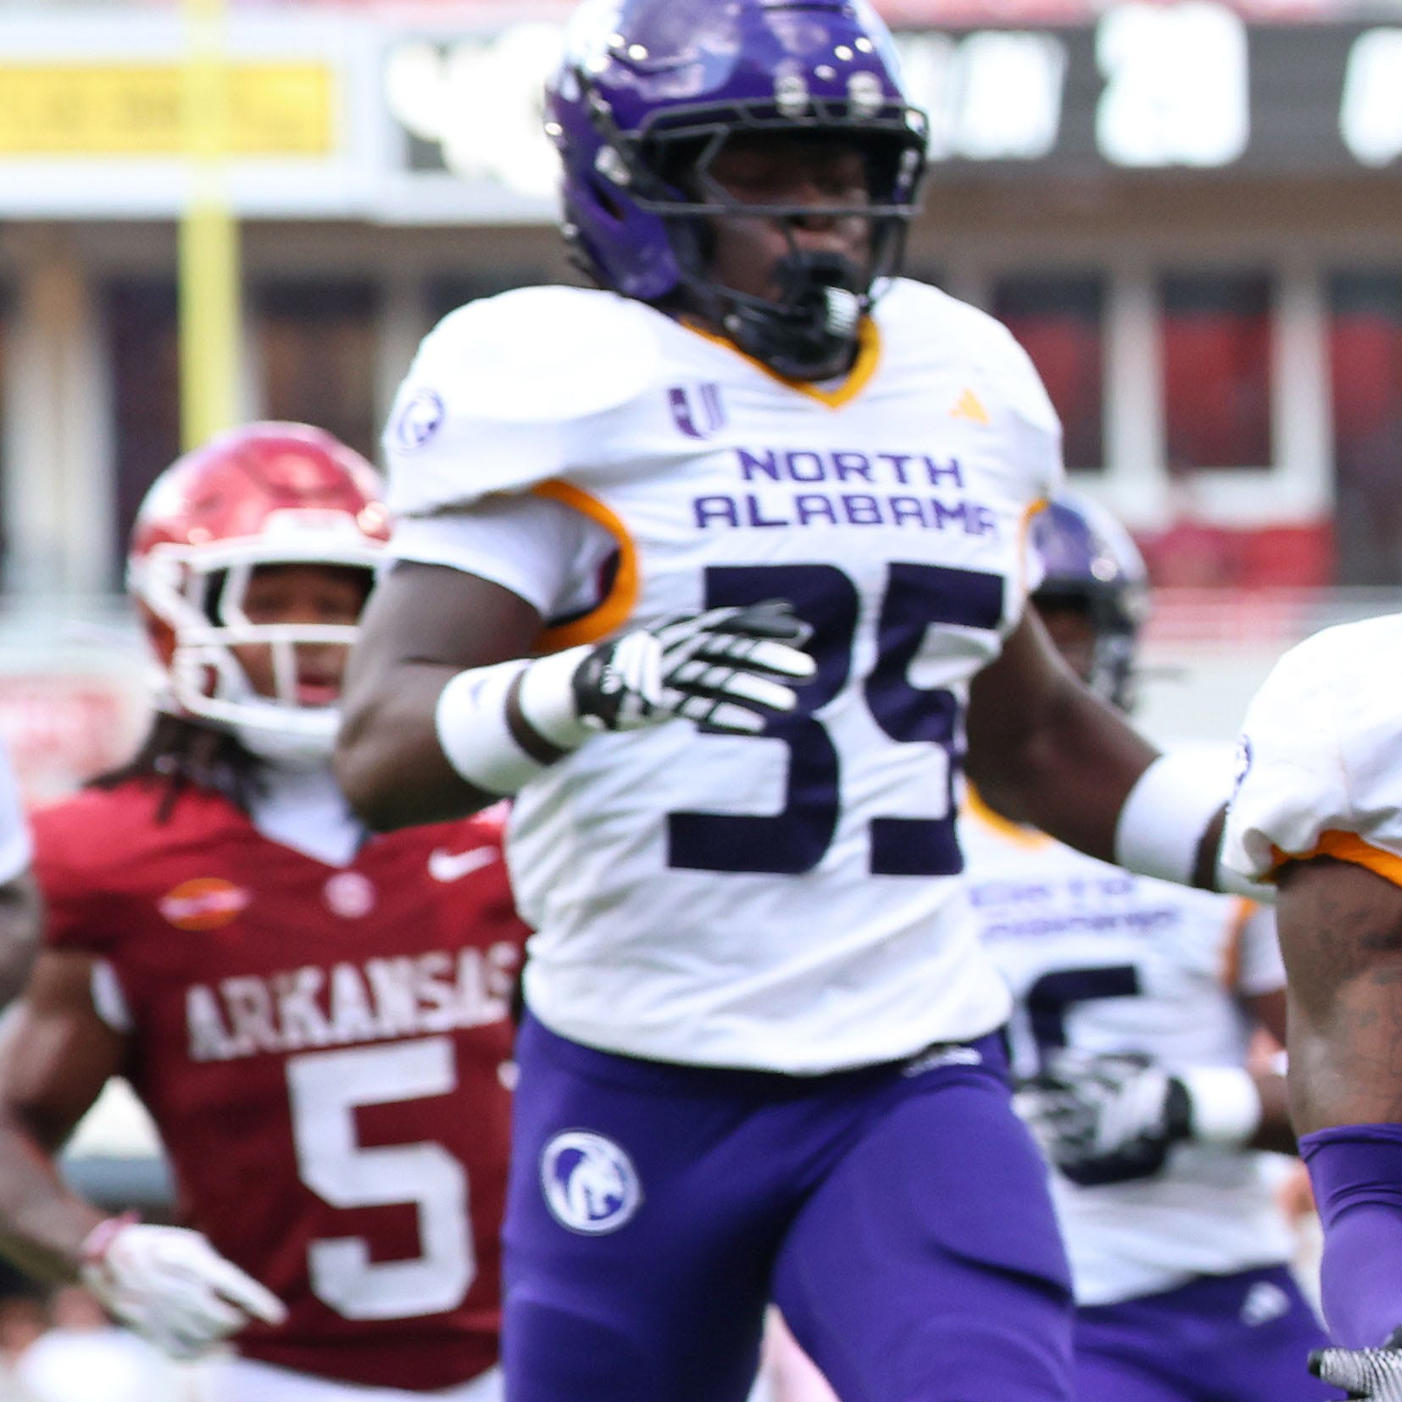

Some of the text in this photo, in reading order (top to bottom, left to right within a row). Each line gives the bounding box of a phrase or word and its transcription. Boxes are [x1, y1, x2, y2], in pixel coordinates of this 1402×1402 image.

[692, 494, 996, 535] ALABAMA
[738, 448, 965, 489] NORTH
[667, 561, 1005, 876] 35
[184, 941, 519, 1062] ARKANSAS
[285, 1034, 478, 1321] 5
